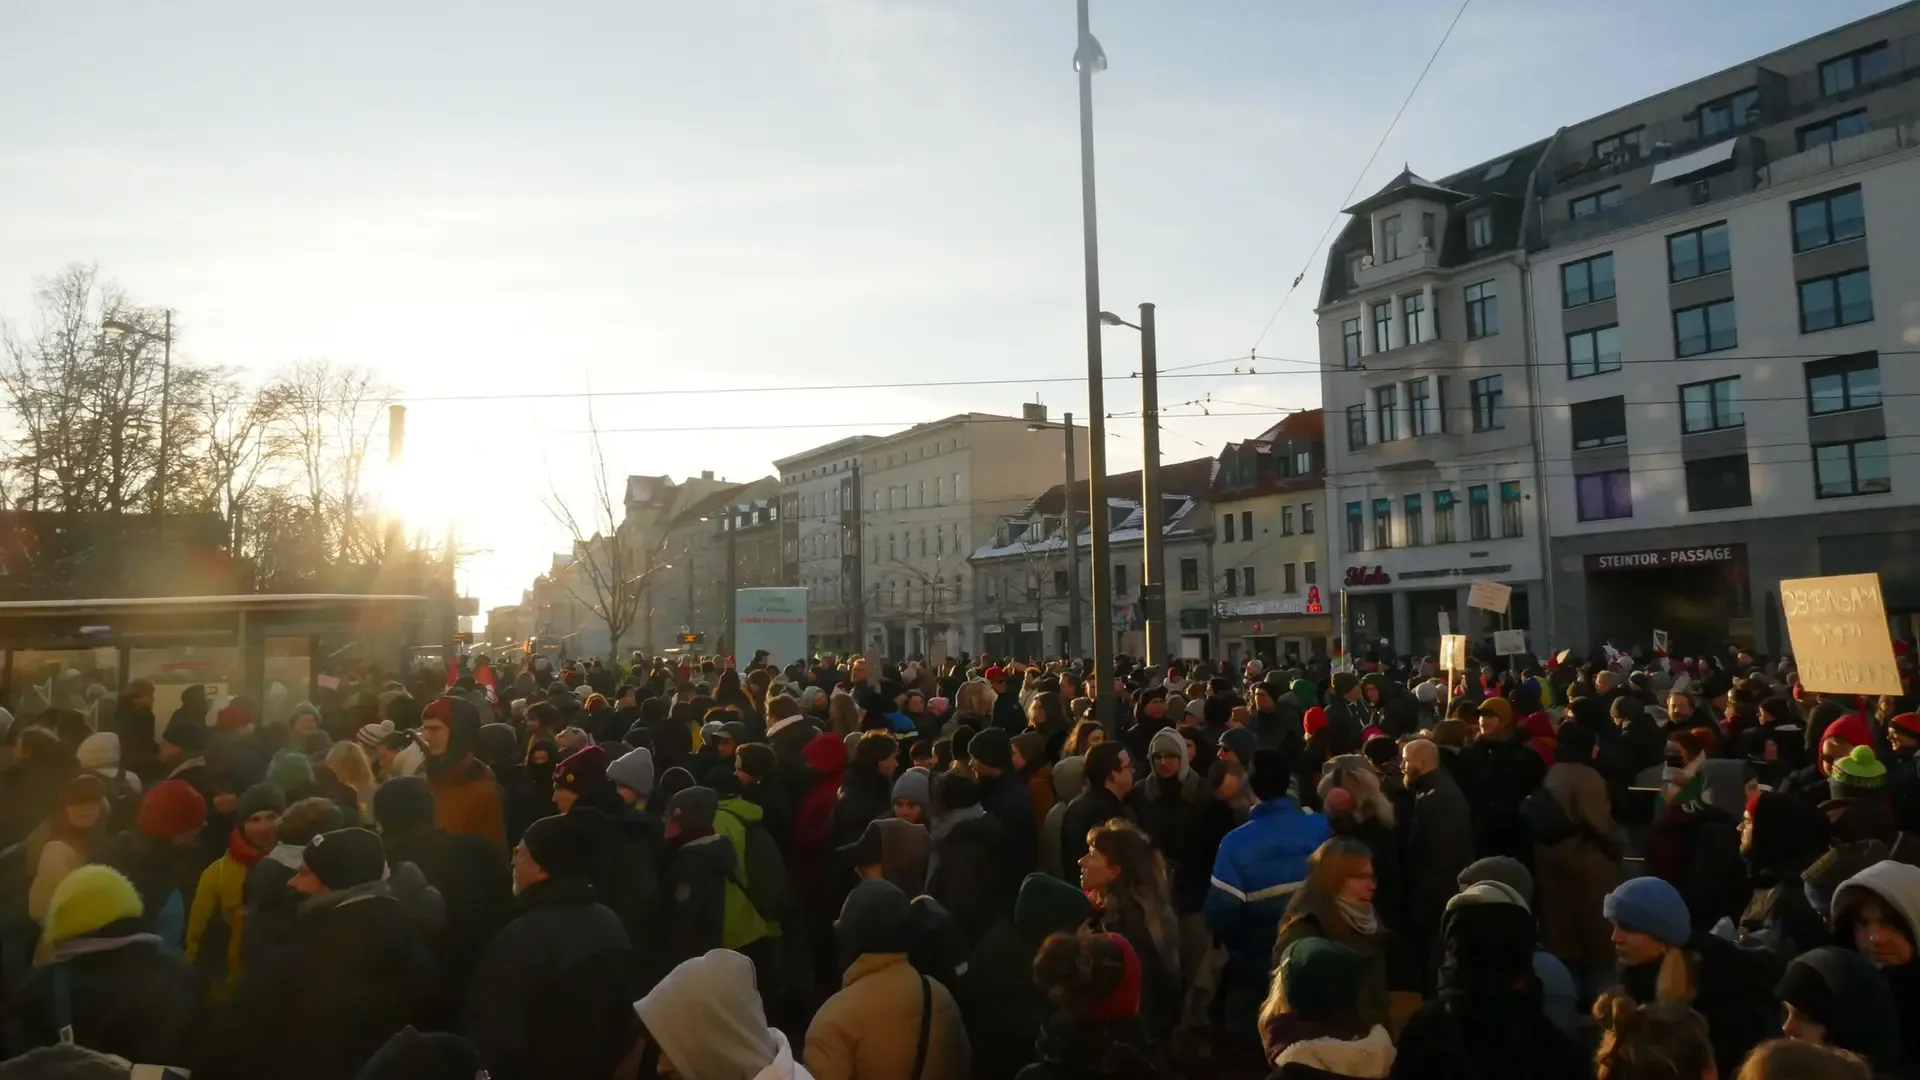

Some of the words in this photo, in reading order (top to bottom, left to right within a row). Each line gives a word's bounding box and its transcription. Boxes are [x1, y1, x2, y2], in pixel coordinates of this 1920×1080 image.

[1599, 553, 1659, 568] STEINTOR
[1670, 547, 1732, 563] PASSAGE
[1782, 586, 1879, 616] GEMEINSAM
[1812, 622, 1863, 646] gegen
